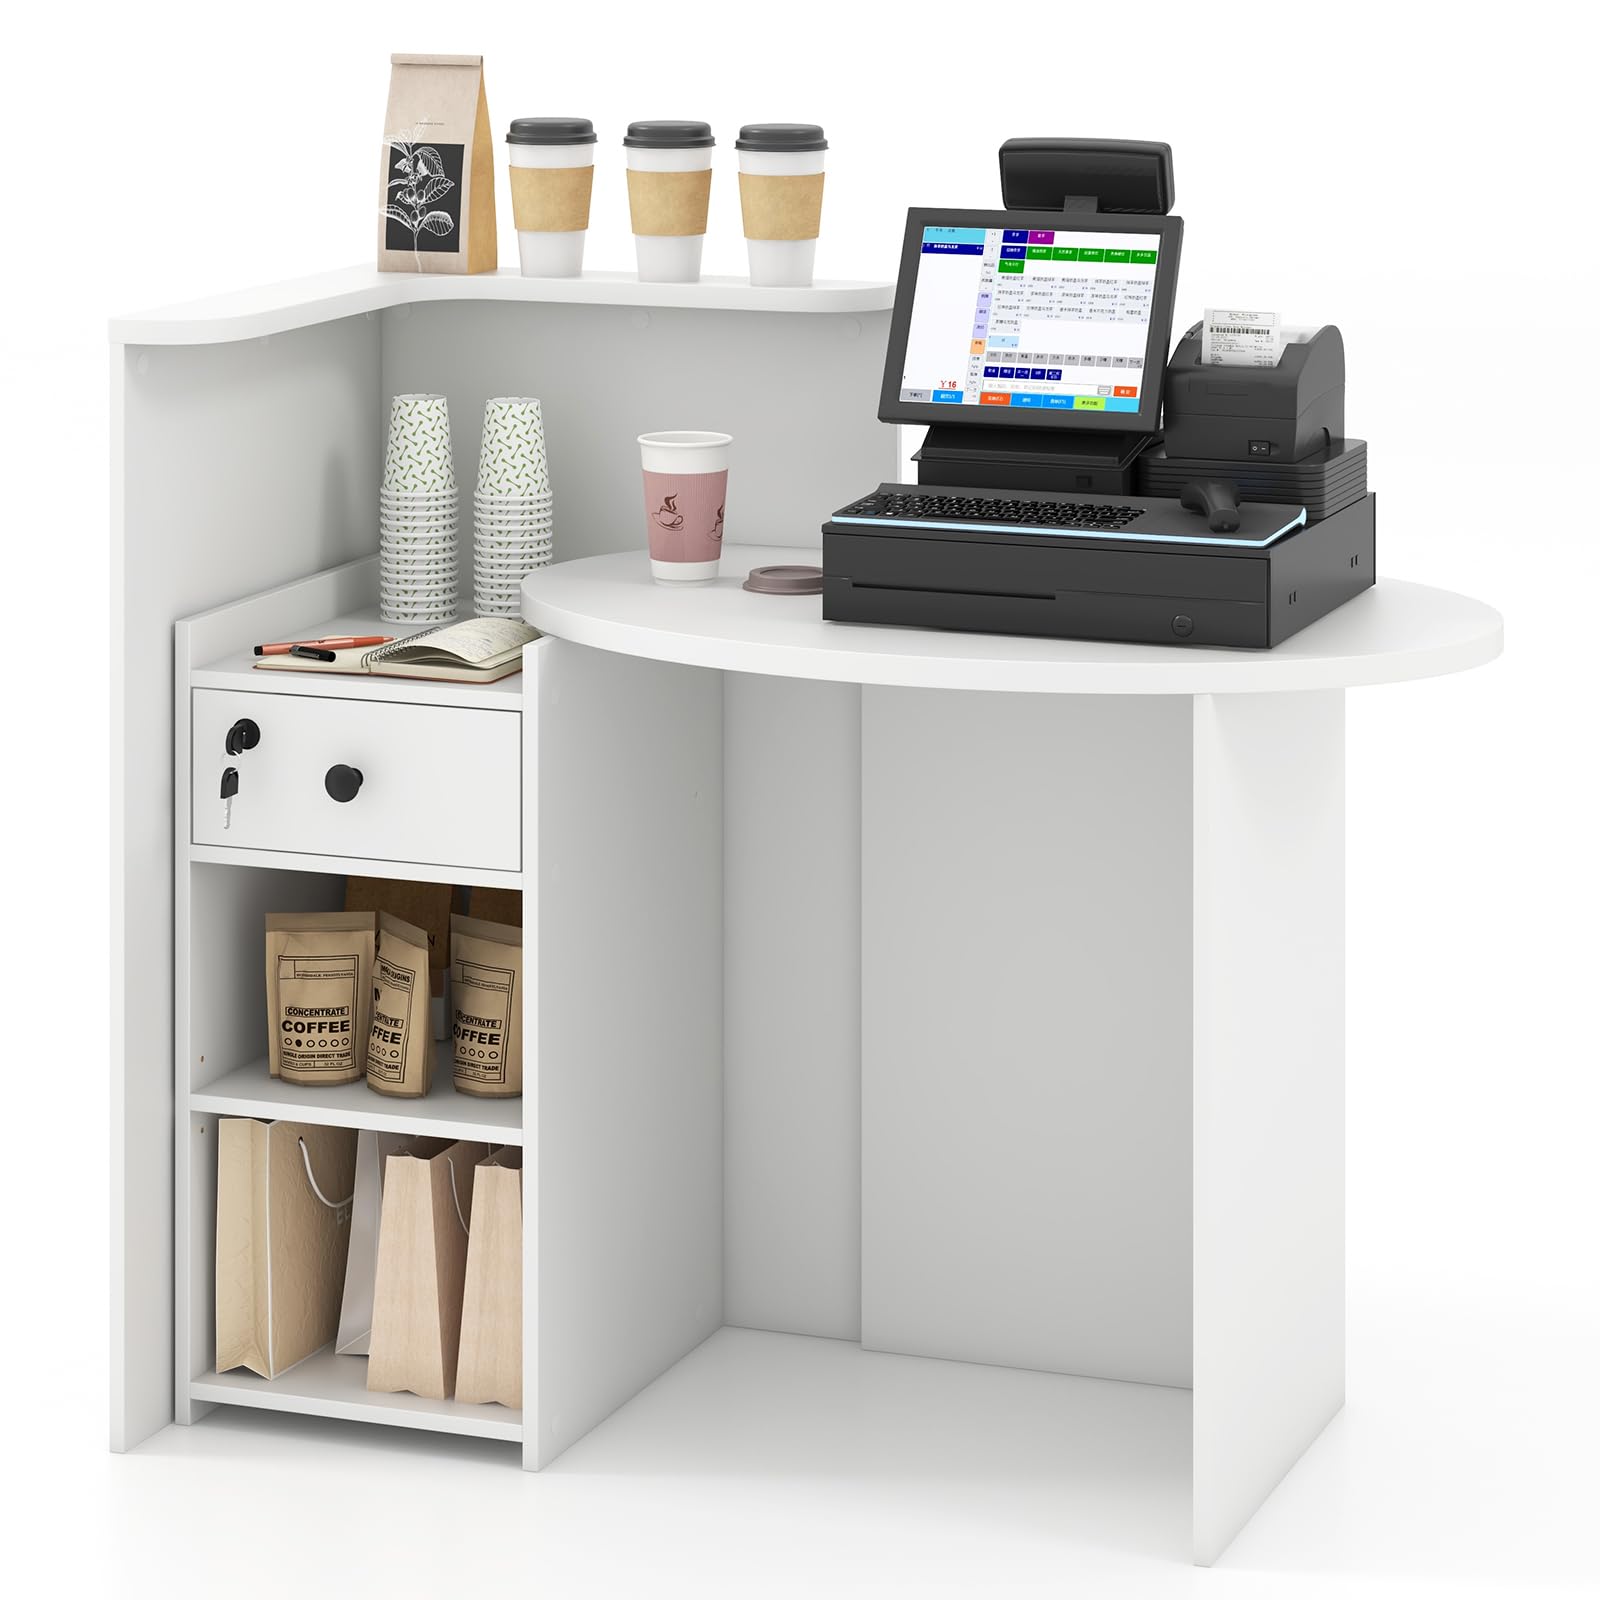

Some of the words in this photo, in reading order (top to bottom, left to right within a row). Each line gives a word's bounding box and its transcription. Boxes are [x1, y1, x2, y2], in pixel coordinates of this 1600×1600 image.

[948, 380, 957, 389] 16
[287, 1007, 345, 1016] CONCENTRATE
[281, 1020, 350, 1034] COFFEE
[453, 1023, 501, 1045] COFFEE
